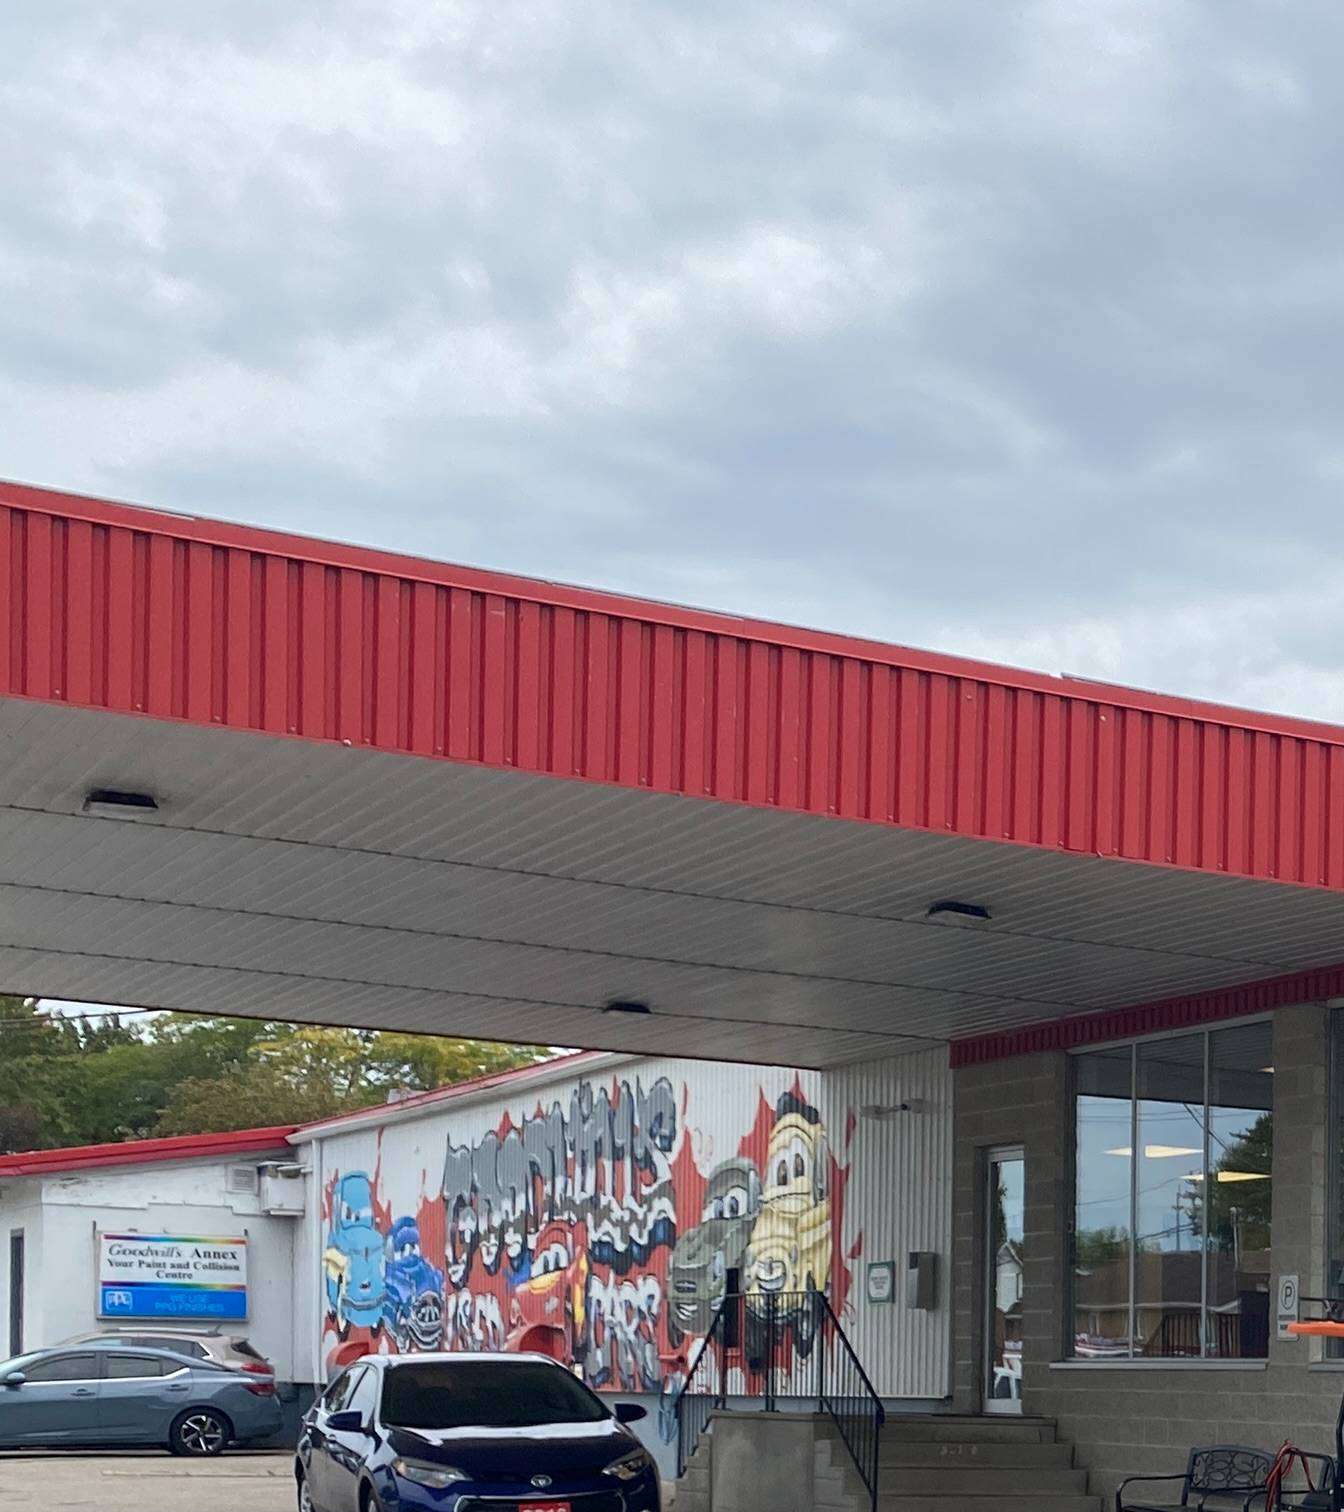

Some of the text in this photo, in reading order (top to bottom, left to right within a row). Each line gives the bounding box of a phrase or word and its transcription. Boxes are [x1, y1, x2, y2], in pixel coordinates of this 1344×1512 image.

[108, 1244, 238, 1260] Goodwill's Annex
[107, 1258, 240, 1271] Your Paint and Collision
[156, 1270, 193, 1279] Centre
